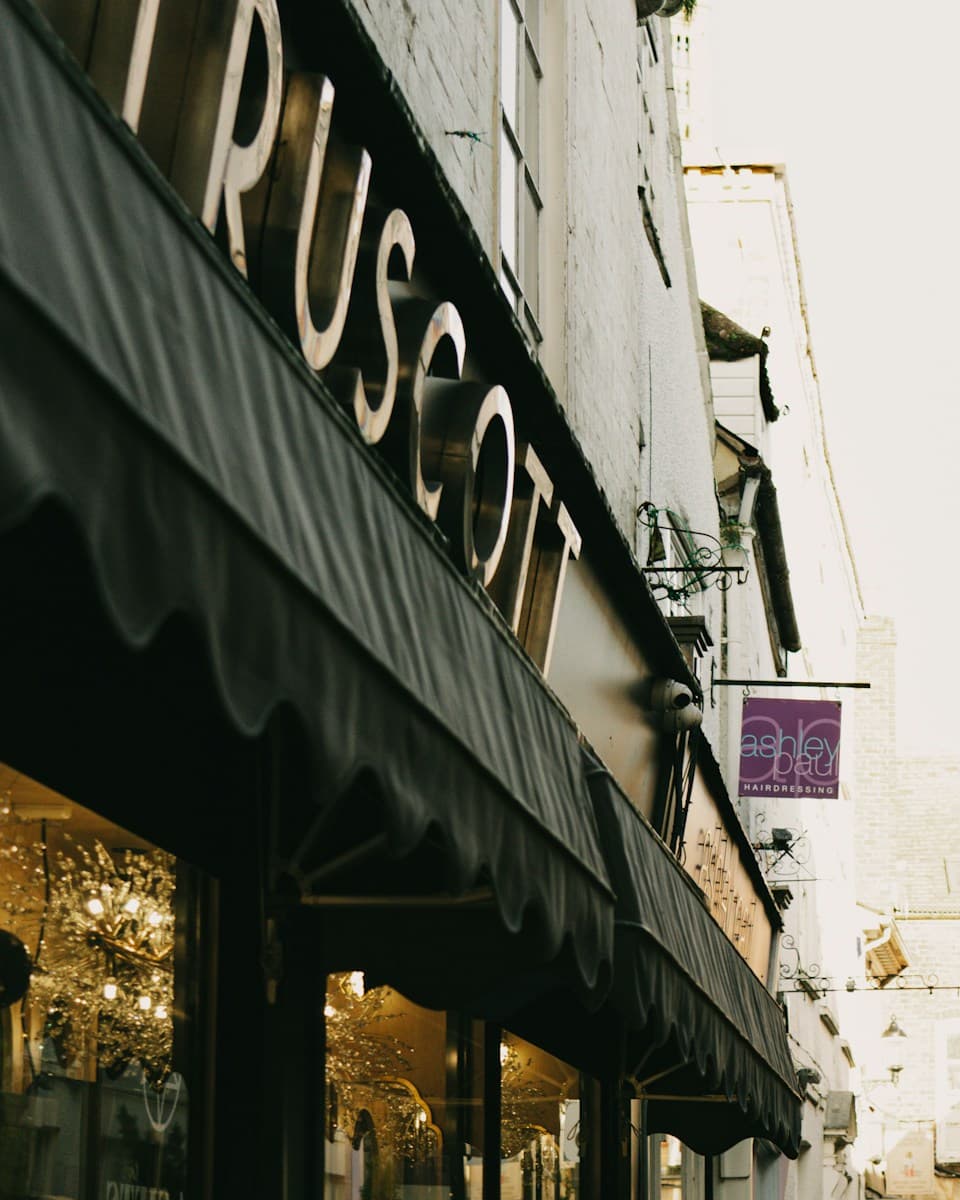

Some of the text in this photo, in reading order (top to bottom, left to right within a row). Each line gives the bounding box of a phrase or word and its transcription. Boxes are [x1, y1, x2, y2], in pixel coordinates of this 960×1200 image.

[740, 727, 841, 767] ashley
[772, 750, 840, 782] paul
[743, 783, 834, 795] HAIRDRESSING
